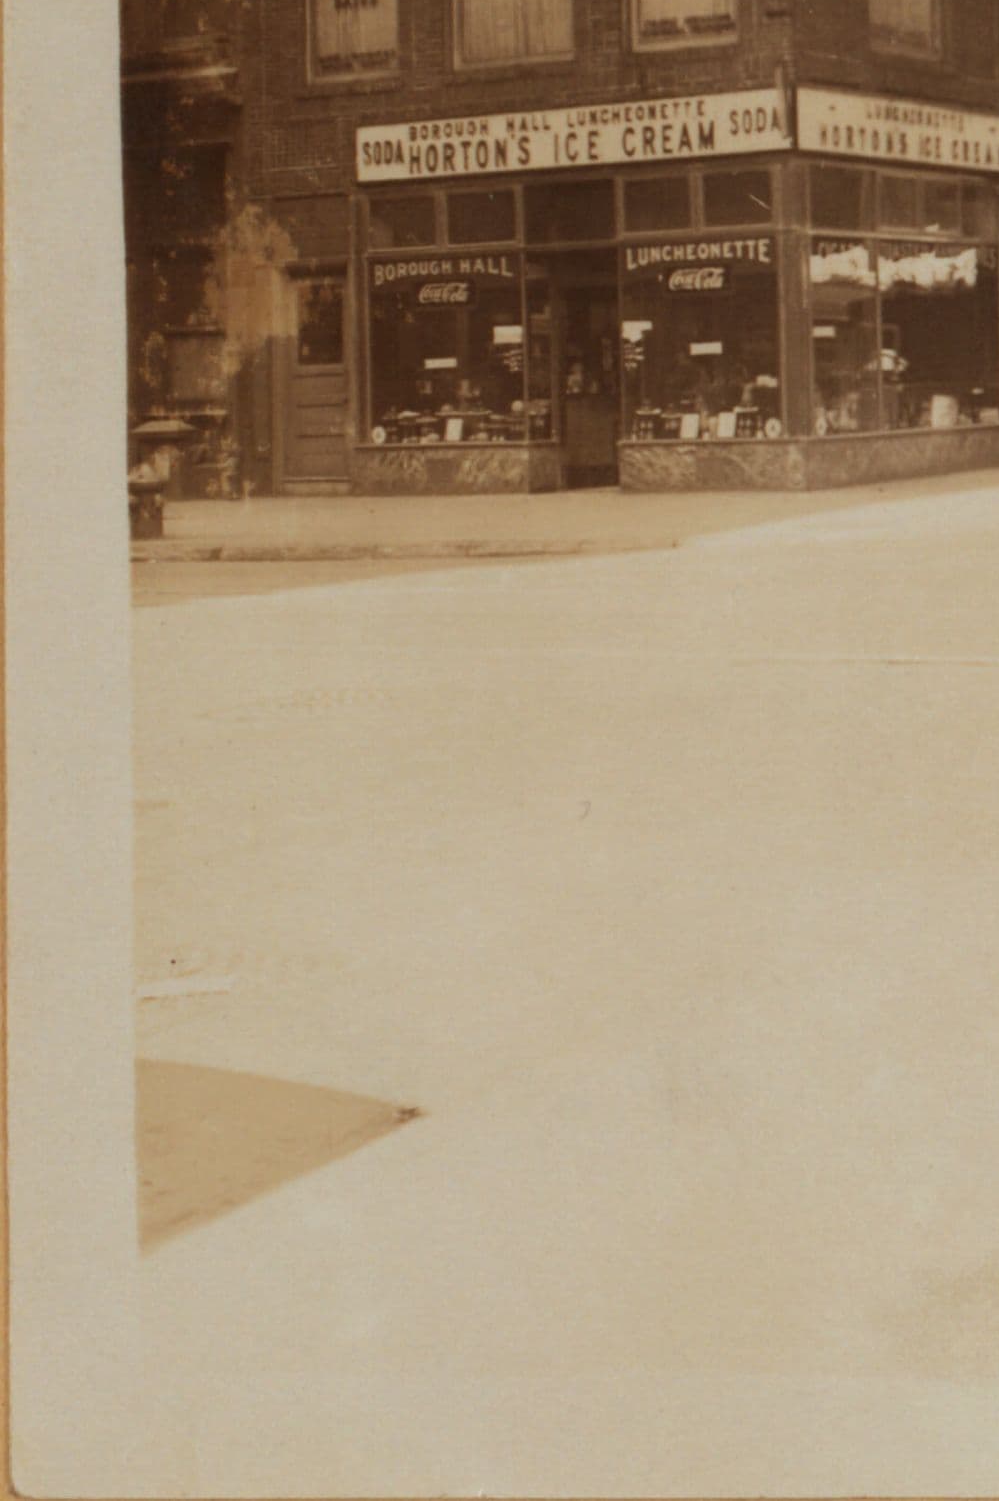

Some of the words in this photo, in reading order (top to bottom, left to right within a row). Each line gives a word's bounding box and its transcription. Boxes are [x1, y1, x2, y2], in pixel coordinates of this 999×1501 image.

[408, 119, 490, 142] BOROUGH
[505, 114, 552, 133] HALL
[565, 98, 706, 129] LUNCHEONETTE
[728, 104, 782, 137] SODA
[362, 139, 406, 166] SODA
[552, 130, 601, 165] ICE
[621, 120, 717, 157] CREAM
[626, 237, 772, 271] LUNCHEONETTE
[374, 258, 454, 286] BOROUGH
[459, 257, 514, 278] HALL
